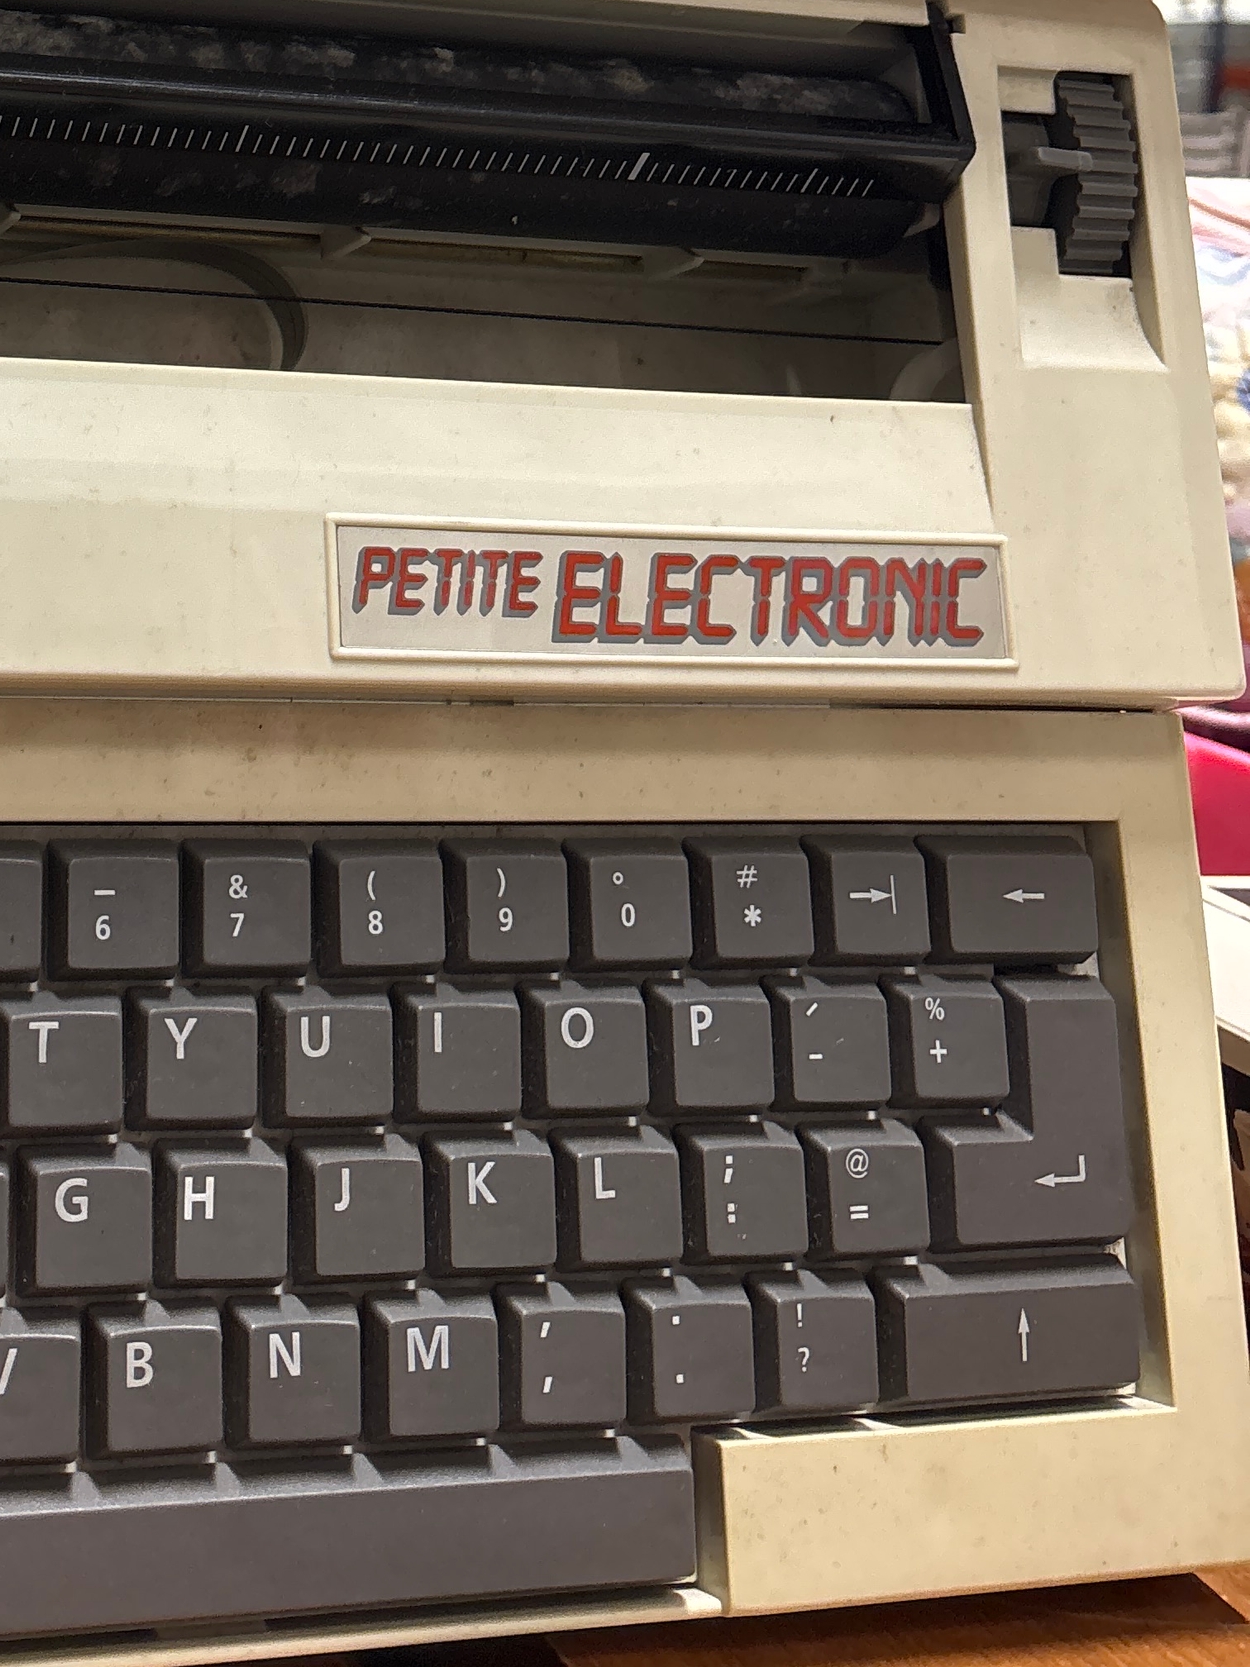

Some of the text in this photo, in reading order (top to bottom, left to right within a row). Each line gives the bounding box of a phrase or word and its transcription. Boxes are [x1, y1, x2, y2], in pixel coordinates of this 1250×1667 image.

[352, 546, 988, 648] PETITE ELECTRONIC
[229, 875, 247, 898] &
[737, 865, 757, 888] #
[96, 916, 110, 940] 6
[231, 913, 244, 936] 7
[369, 911, 382, 934] 8
[499, 908, 512, 931] 9
[622, 904, 635, 926] 0
[562, 1008, 593, 1048] O
[691, 1005, 712, 1045] P
[925, 998, 944, 1020] %
[29, 1022, 59, 1063] T
[165, 1018, 197, 1059] Y
[301, 1016, 330, 1057] U
[434, 1013, 442, 1052] I
[930, 1040, 947, 1063] +
[468, 1162, 497, 1204] K
[595, 1157, 615, 1199] L
[846, 1149, 868, 1178] @
[55, 1178, 88, 1222] G
[184, 1177, 214, 1220] H
[335, 1168, 349, 1211] J
[797, 1304, 802, 1327] !
[127, 1342, 153, 1387] B
[270, 1332, 300, 1378] N
[407, 1326, 449, 1372] M
[798, 1347, 809, 1371] ?
